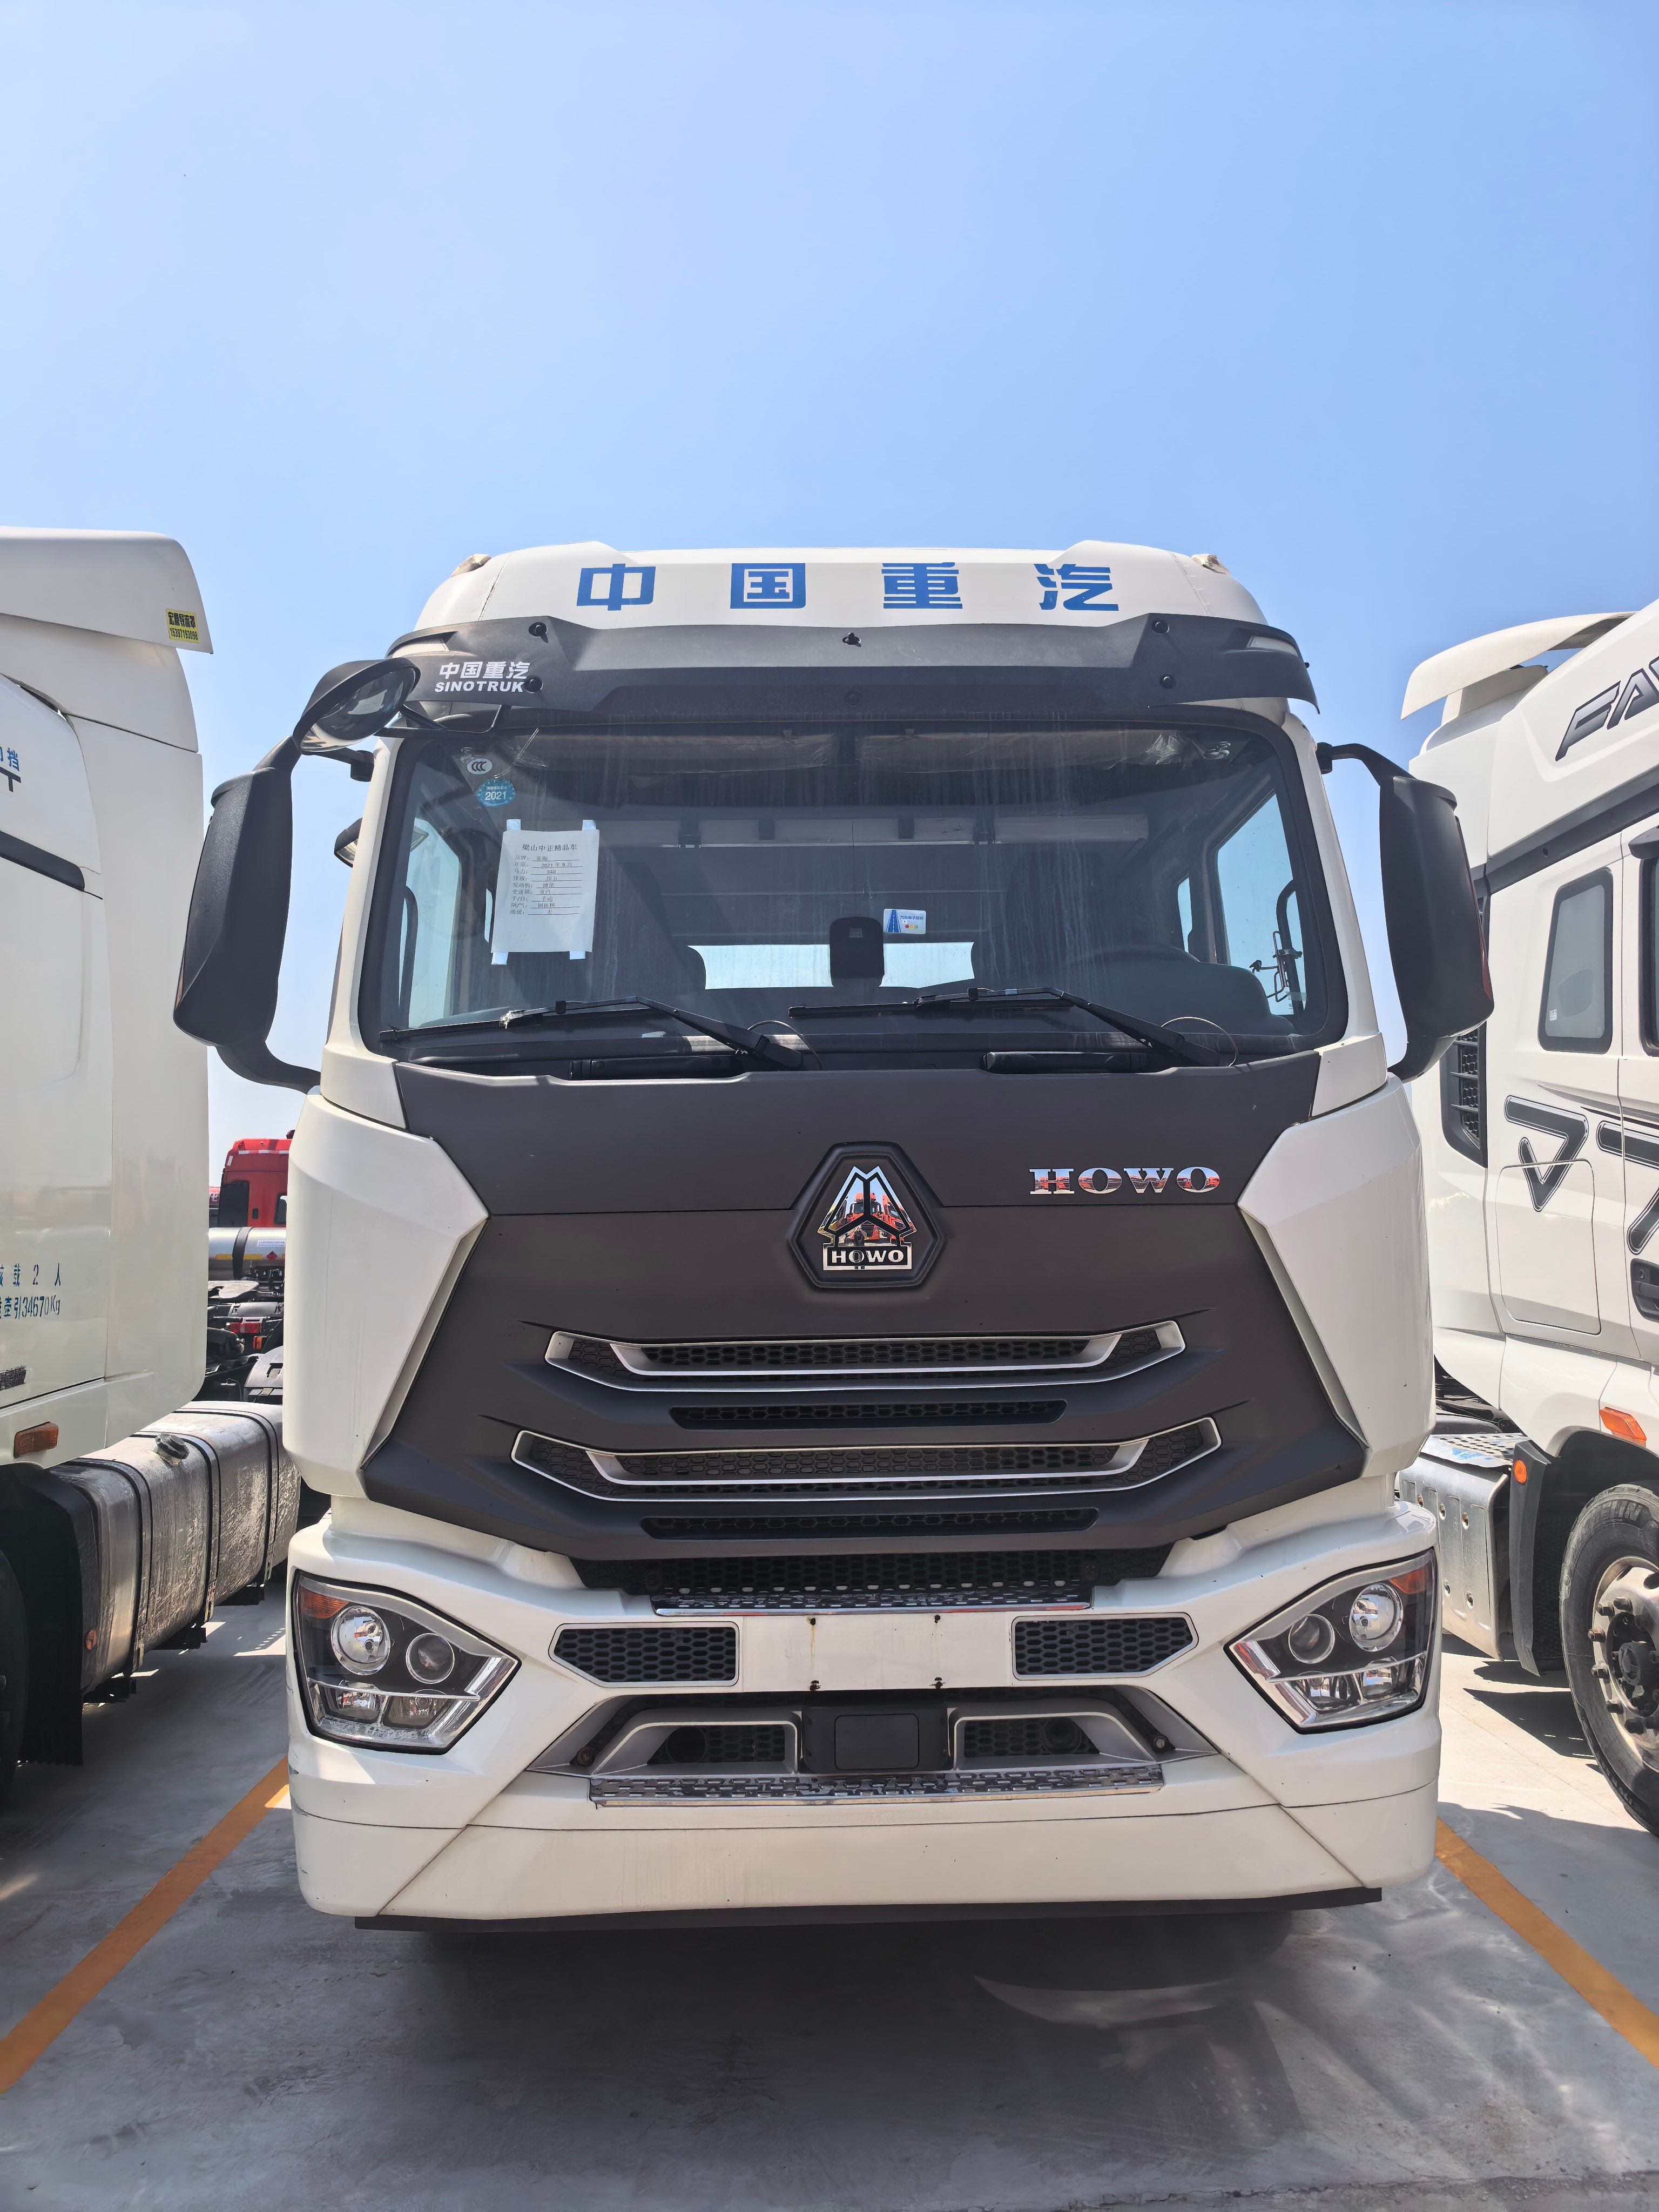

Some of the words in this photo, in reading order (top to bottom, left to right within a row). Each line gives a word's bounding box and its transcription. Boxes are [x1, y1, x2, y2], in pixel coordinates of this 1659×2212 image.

[577, 563, 1118, 611] 中国重汽
[439, 661, 530, 679] 中国重汽
[435, 681, 525, 692] SINOTRUK
[1555, 656, 1659, 762] FA
[0, 746, 19, 771] 挡
[485, 791, 507, 800] 2021
[1029, 1166, 1220, 1195] HOWO
[832, 1250, 904, 1263] HOWO
